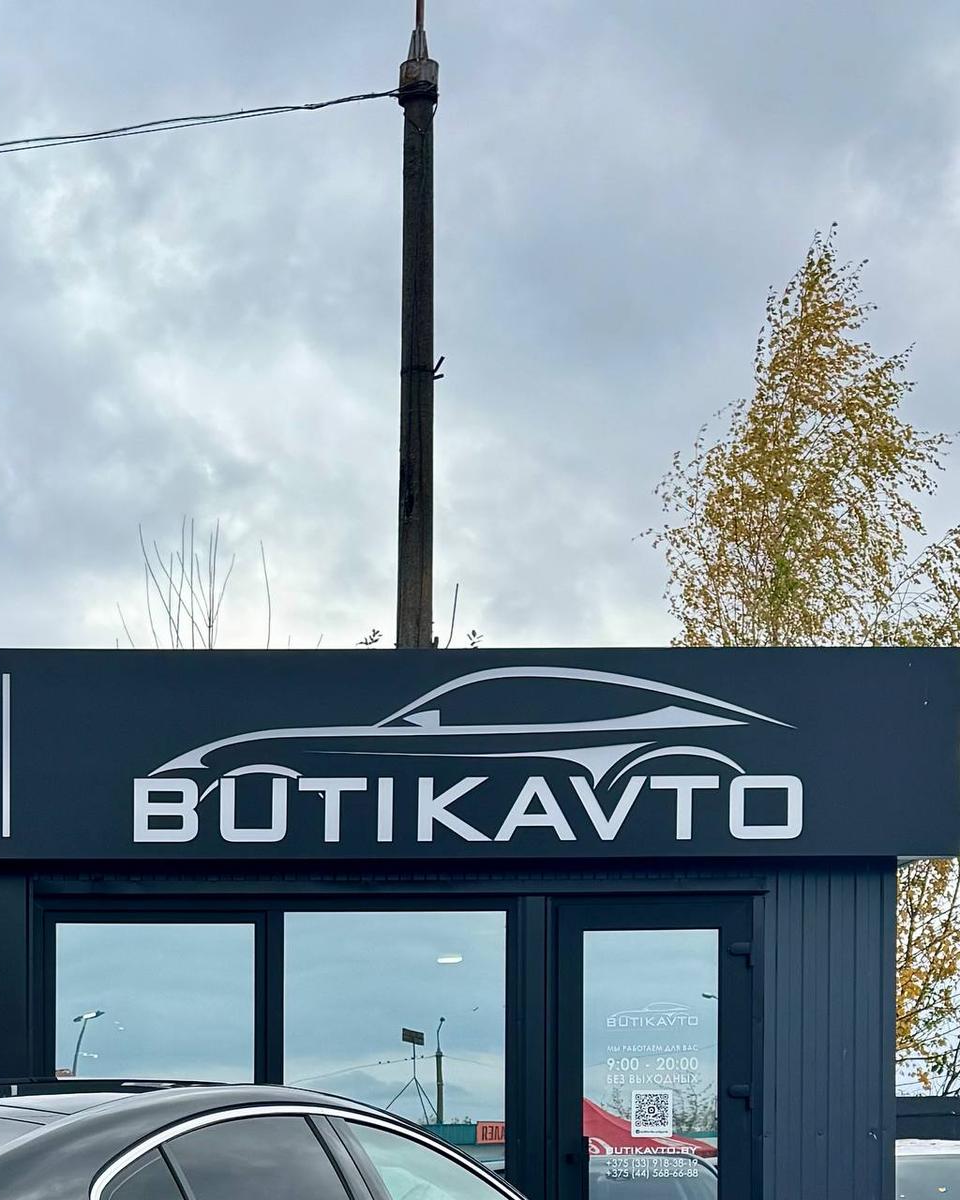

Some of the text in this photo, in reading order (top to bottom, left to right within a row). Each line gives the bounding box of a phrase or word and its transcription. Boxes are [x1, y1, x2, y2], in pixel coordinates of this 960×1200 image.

[132, 774, 804, 843] BUTIKAVTO
[606, 1016, 699, 1027] BUTIKAVTO
[682, 1044, 698, 1052] ВАС
[607, 1057, 639, 1071] 9:00
[655, 1057, 699, 1071] 20:00
[607, 1073, 698, 1085] БЕЗ ВЫХОДНЫХ
[606, 1146, 698, 1154] BUTIKAVTO.BY
[606, 1159, 699, 1169] +375 (33) 918-38-19
[606, 1169, 699, 1179] +375 (44) 568-66-88
